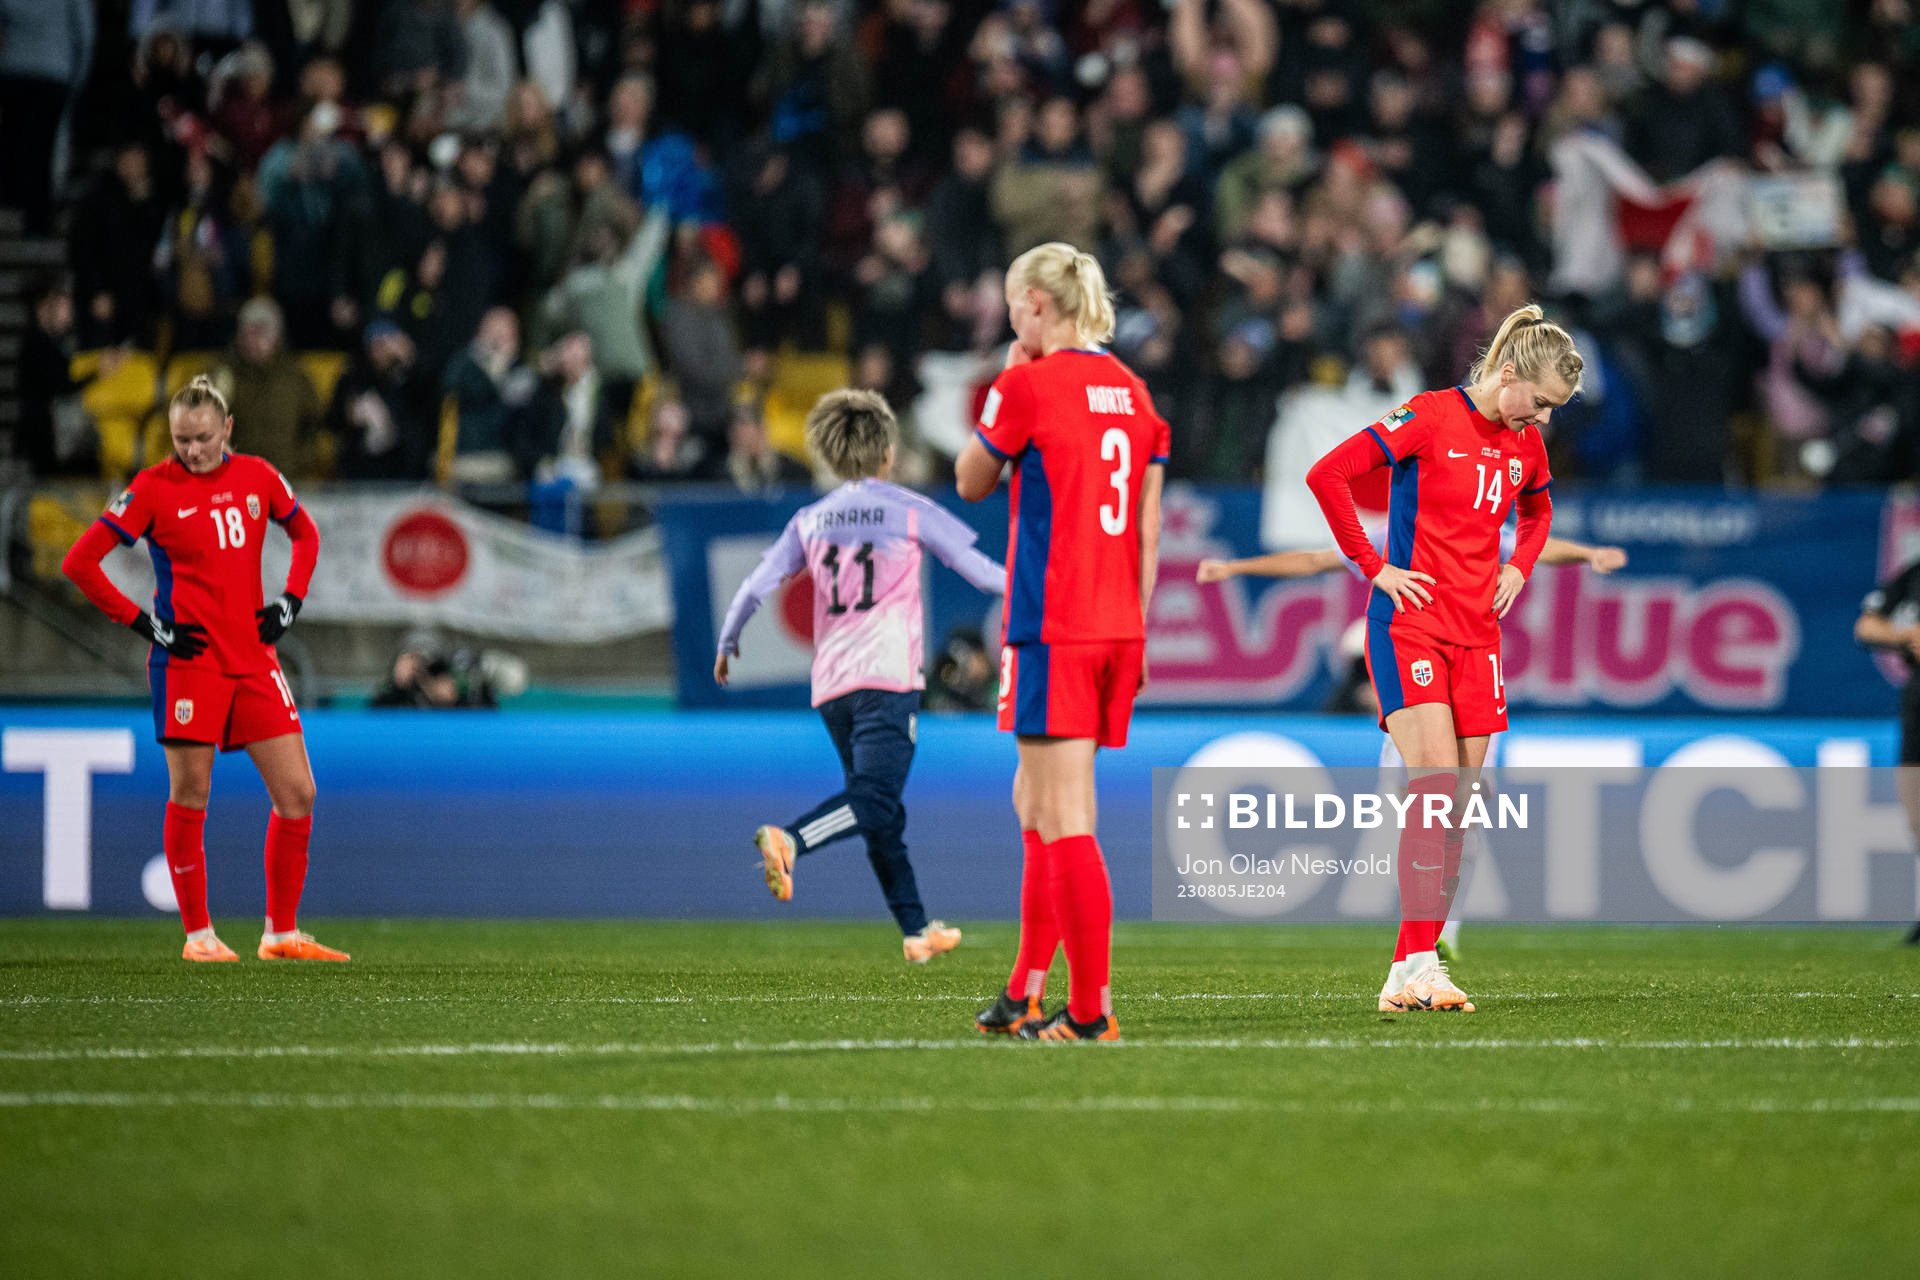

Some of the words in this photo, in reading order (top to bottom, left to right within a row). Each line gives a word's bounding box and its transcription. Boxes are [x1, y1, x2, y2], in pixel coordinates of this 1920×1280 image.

[1085, 384, 1136, 416] HØRTE
[1099, 427, 1131, 536] 3
[1473, 463, 1502, 514] 14
[210, 506, 246, 550] 18
[816, 505, 885, 531] TANAKA
[822, 541, 878, 617] 11
